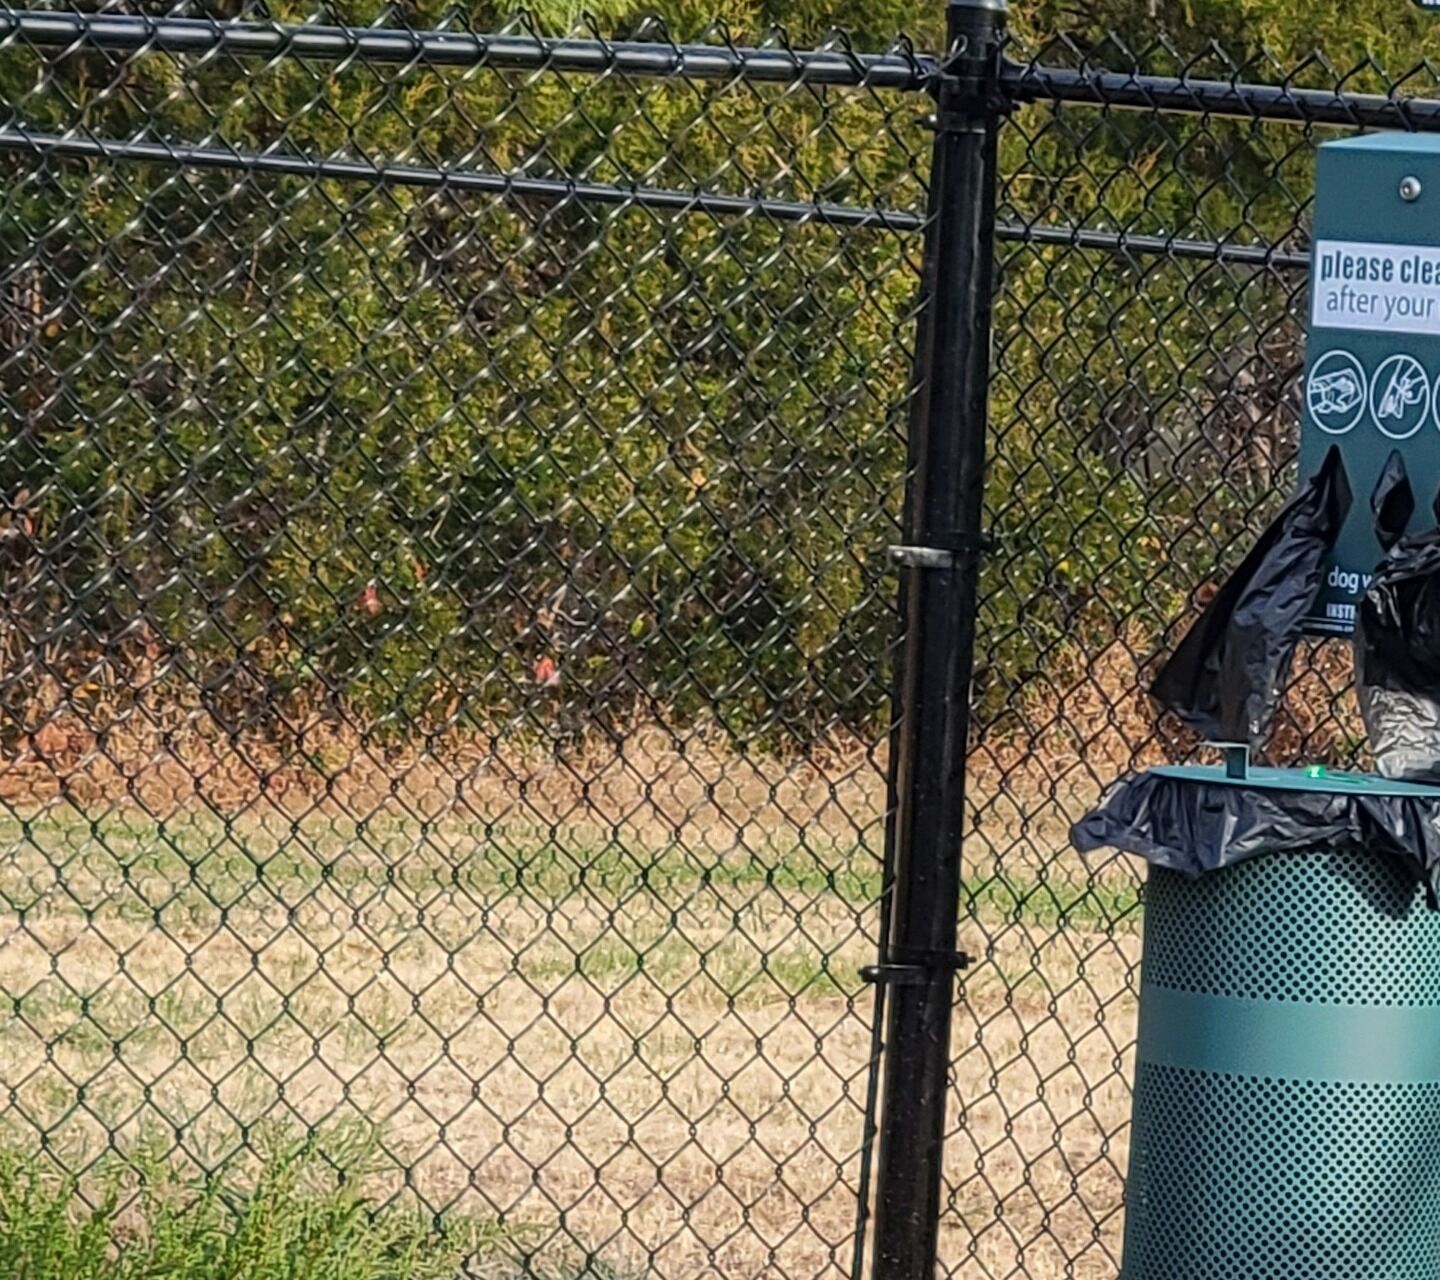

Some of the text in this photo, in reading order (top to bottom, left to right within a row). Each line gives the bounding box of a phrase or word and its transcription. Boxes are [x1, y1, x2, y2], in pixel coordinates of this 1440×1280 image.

[1320, 251, 1394, 282] please
[1326, 286, 1379, 314] after
[1384, 294, 1435, 321] your
[1328, 566, 1358, 593] dog
